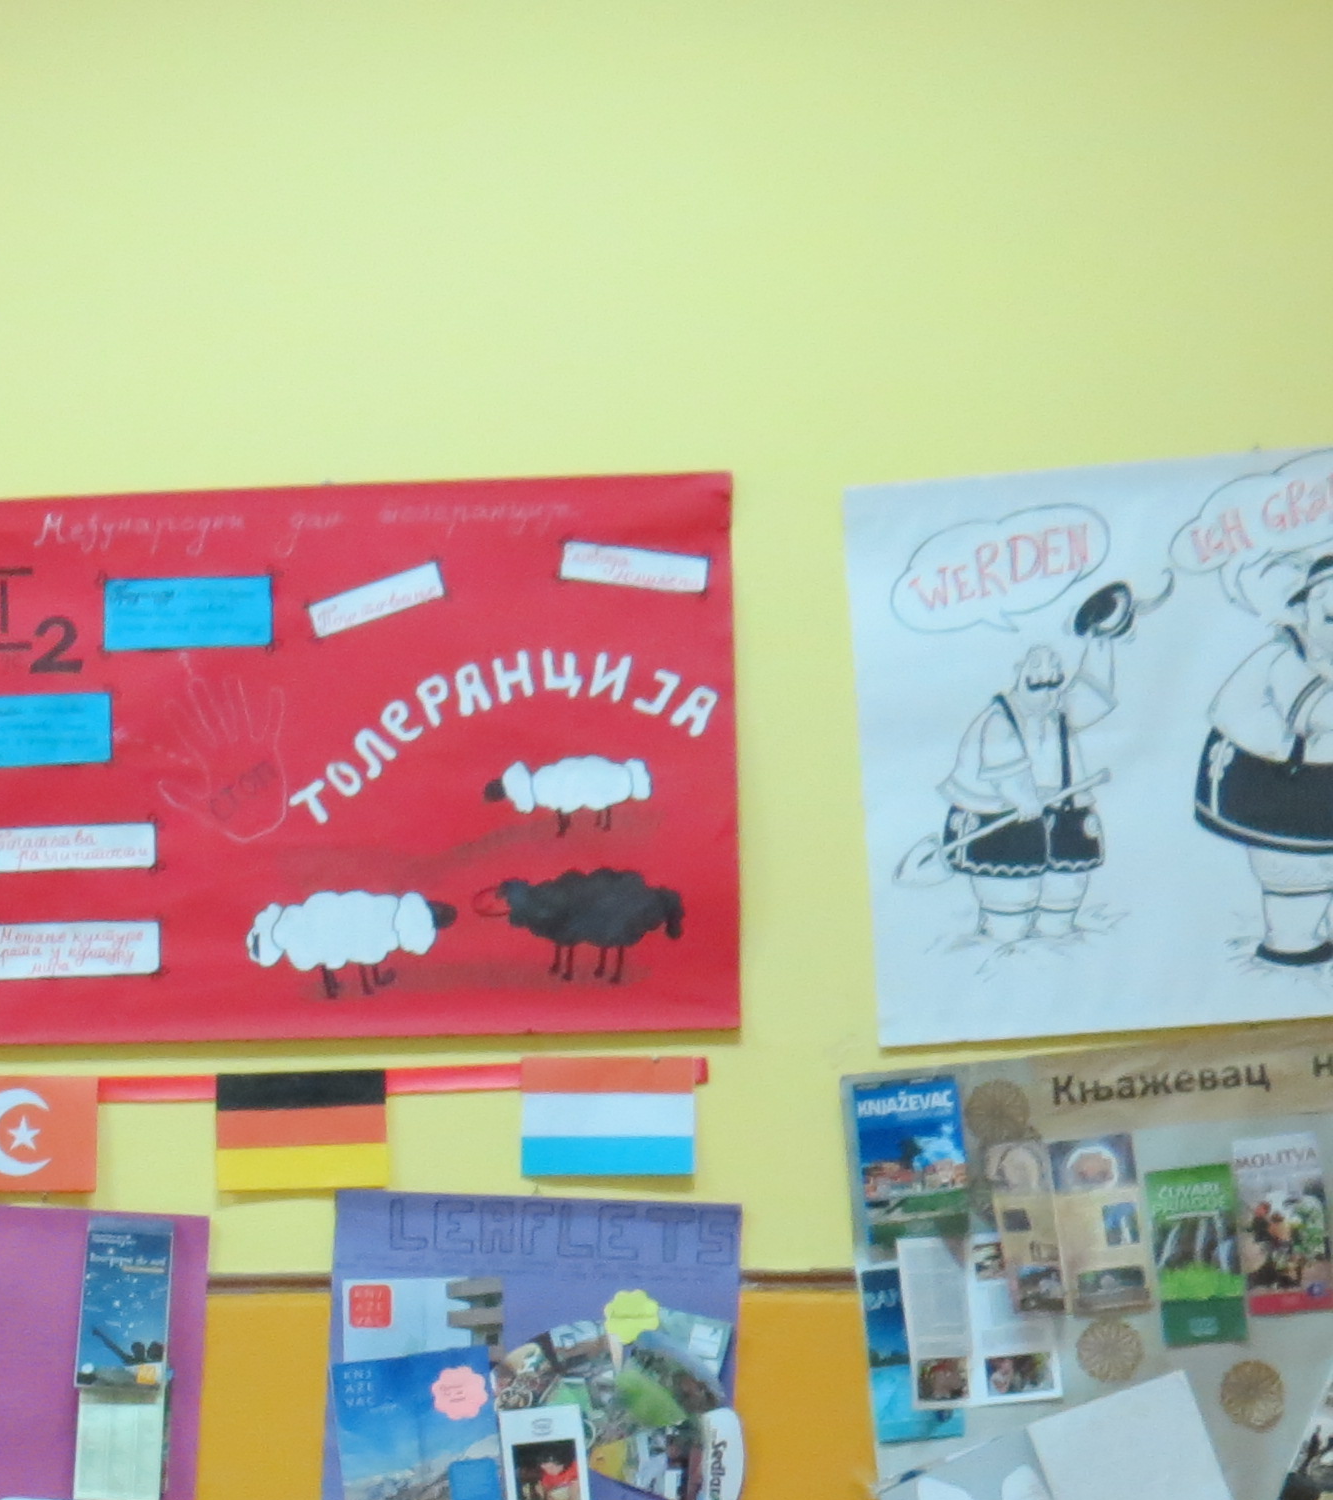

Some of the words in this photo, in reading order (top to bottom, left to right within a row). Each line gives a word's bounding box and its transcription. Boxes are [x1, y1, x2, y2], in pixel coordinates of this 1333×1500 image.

[907, 524, 1090, 613] WERDEN
[1052, 1063, 1272, 1108] Књажевац
[1233, 1148, 1318, 1170] MOLITVA
[388, 1197, 739, 1267] LEAFLETS
